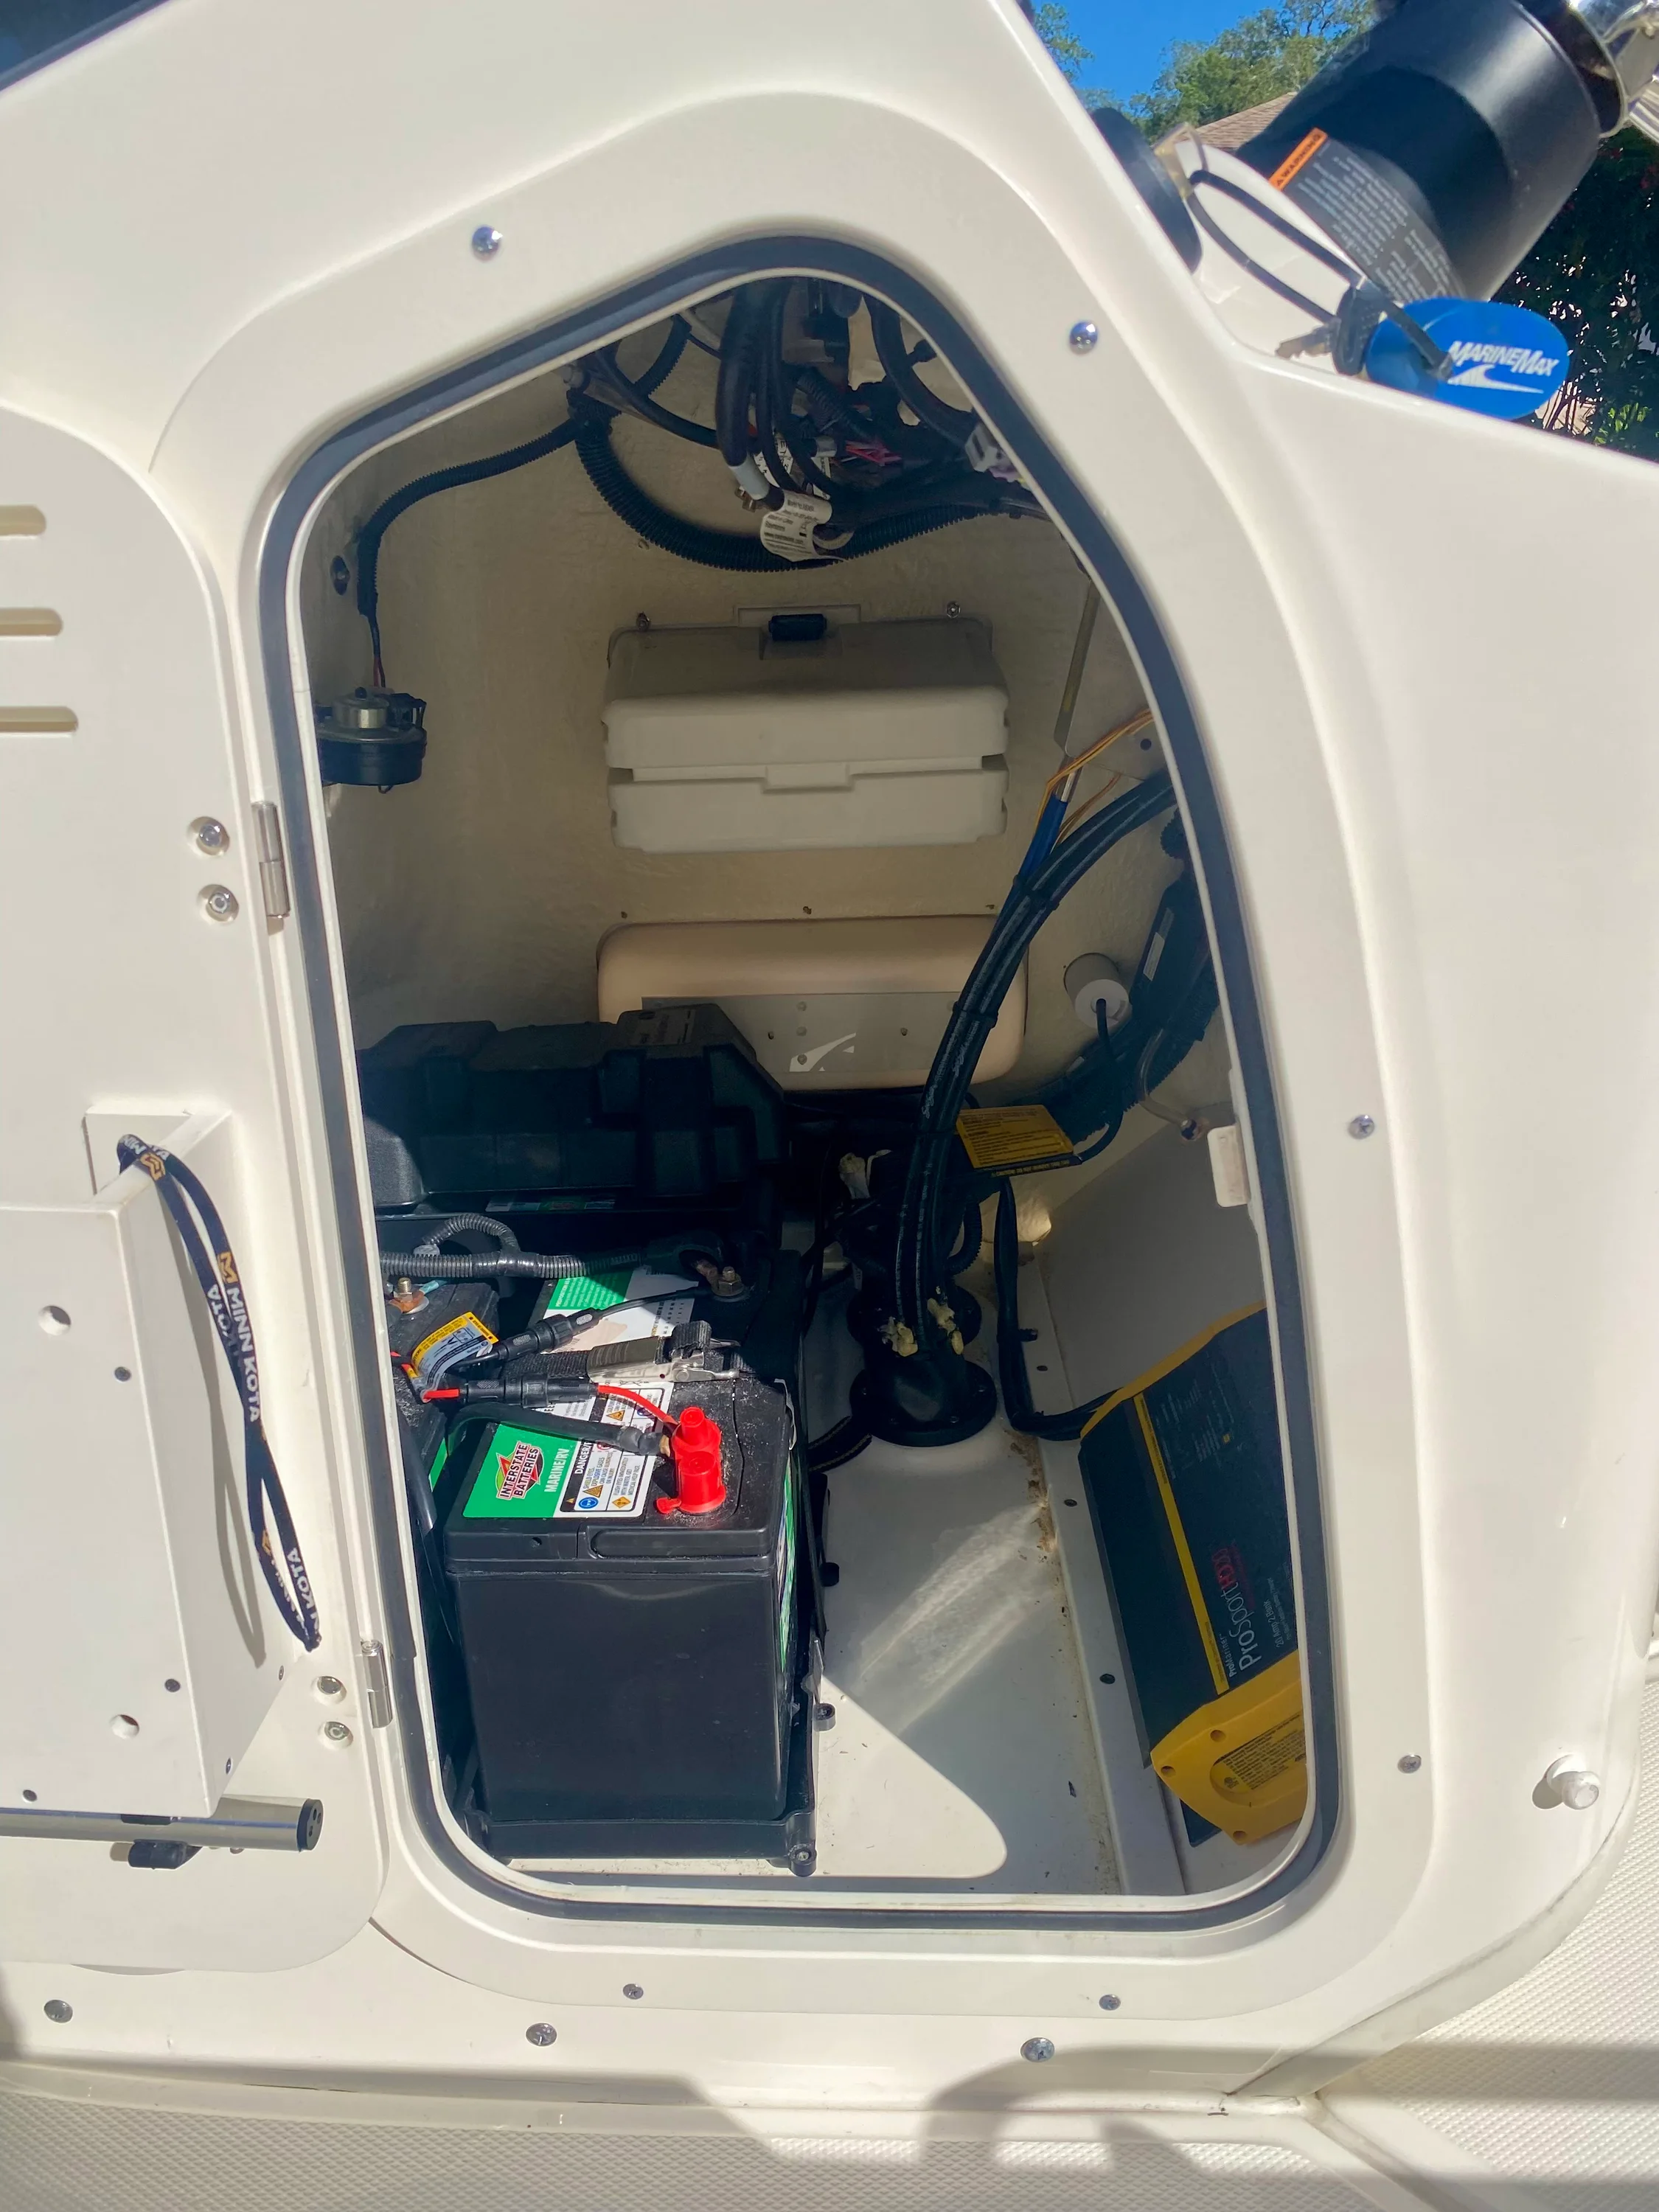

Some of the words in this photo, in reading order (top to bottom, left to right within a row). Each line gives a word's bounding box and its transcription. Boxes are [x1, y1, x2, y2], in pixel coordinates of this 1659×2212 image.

[227, 1287, 254, 1352] MINN
[243, 1357, 260, 1422] KOTA
[500, 1444, 528, 1498] INTERSTATE
[514, 1448, 539, 1496] BATTERIES
[544, 1448, 570, 1492] MARINE/RV
[288, 1547, 316, 1610] KOTA
